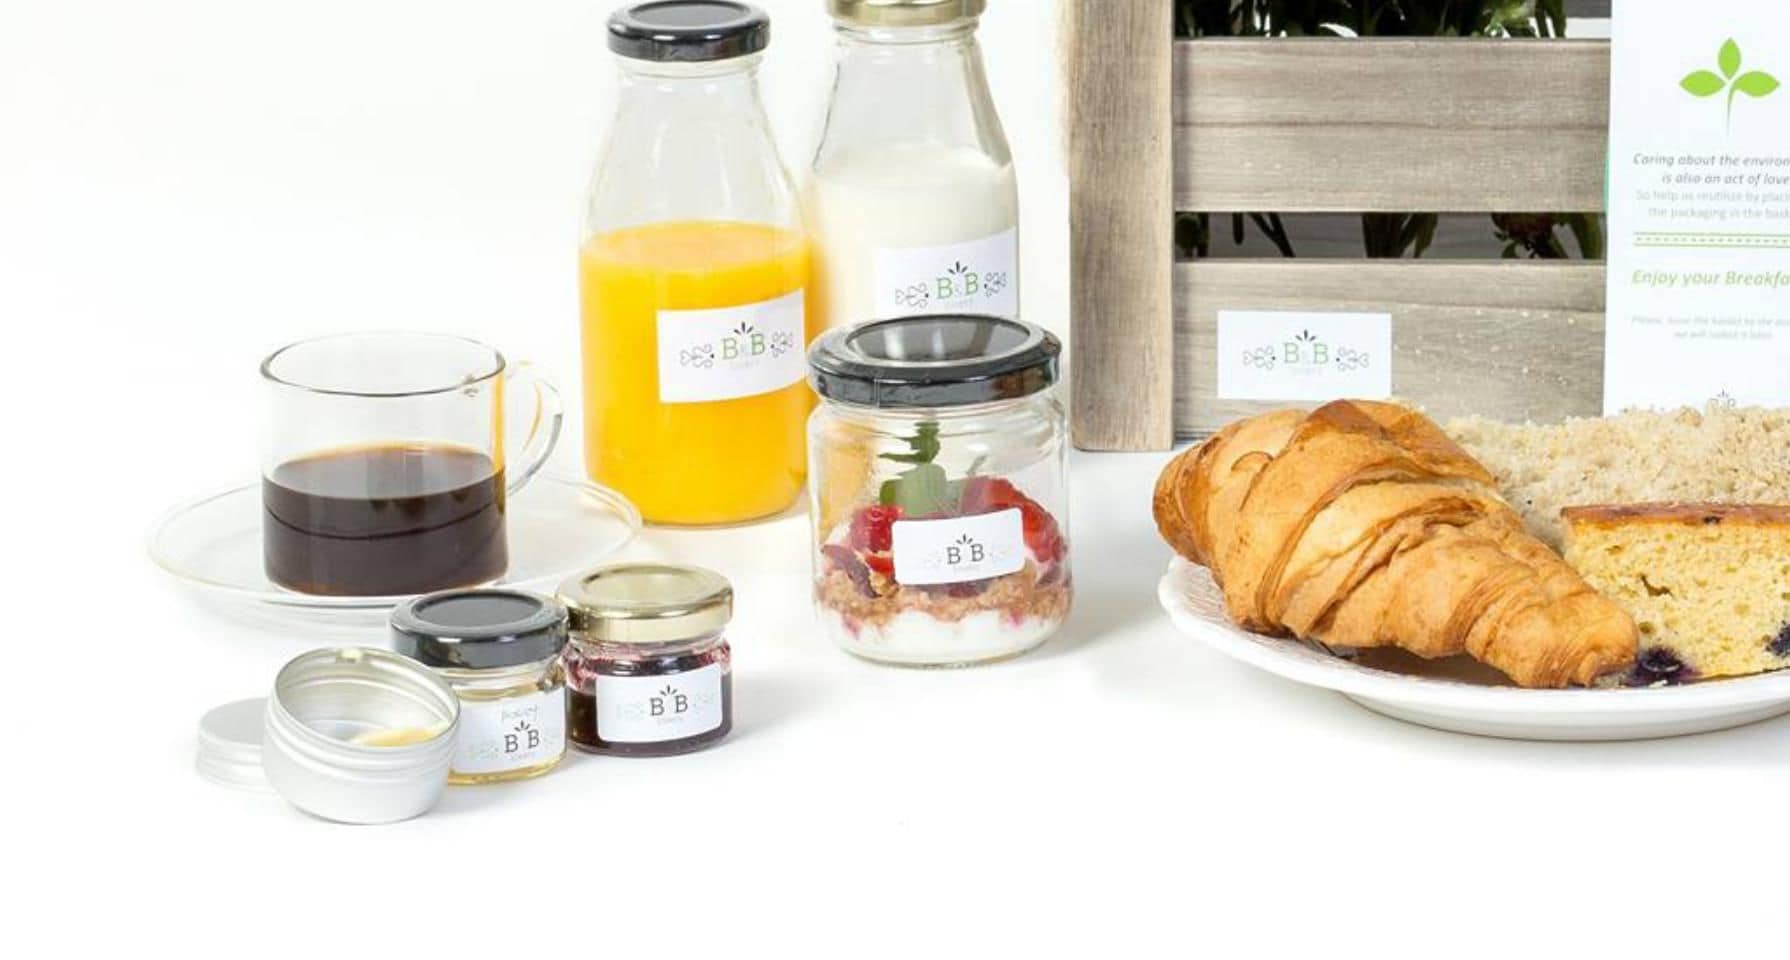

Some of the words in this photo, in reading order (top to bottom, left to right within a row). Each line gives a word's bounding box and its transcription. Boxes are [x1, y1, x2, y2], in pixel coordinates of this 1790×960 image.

[1632, 153, 1675, 167] Caring
[1678, 153, 1716, 166] about
[1719, 154, 1739, 166] the
[1661, 173, 1672, 184] is
[1675, 173, 1702, 184] also
[1704, 175, 1721, 184] an
[1724, 174, 1744, 185] act
[1746, 173, 1761, 187] of
[1631, 269, 1678, 287] Enjoy
[1682, 272, 1721, 287] your
